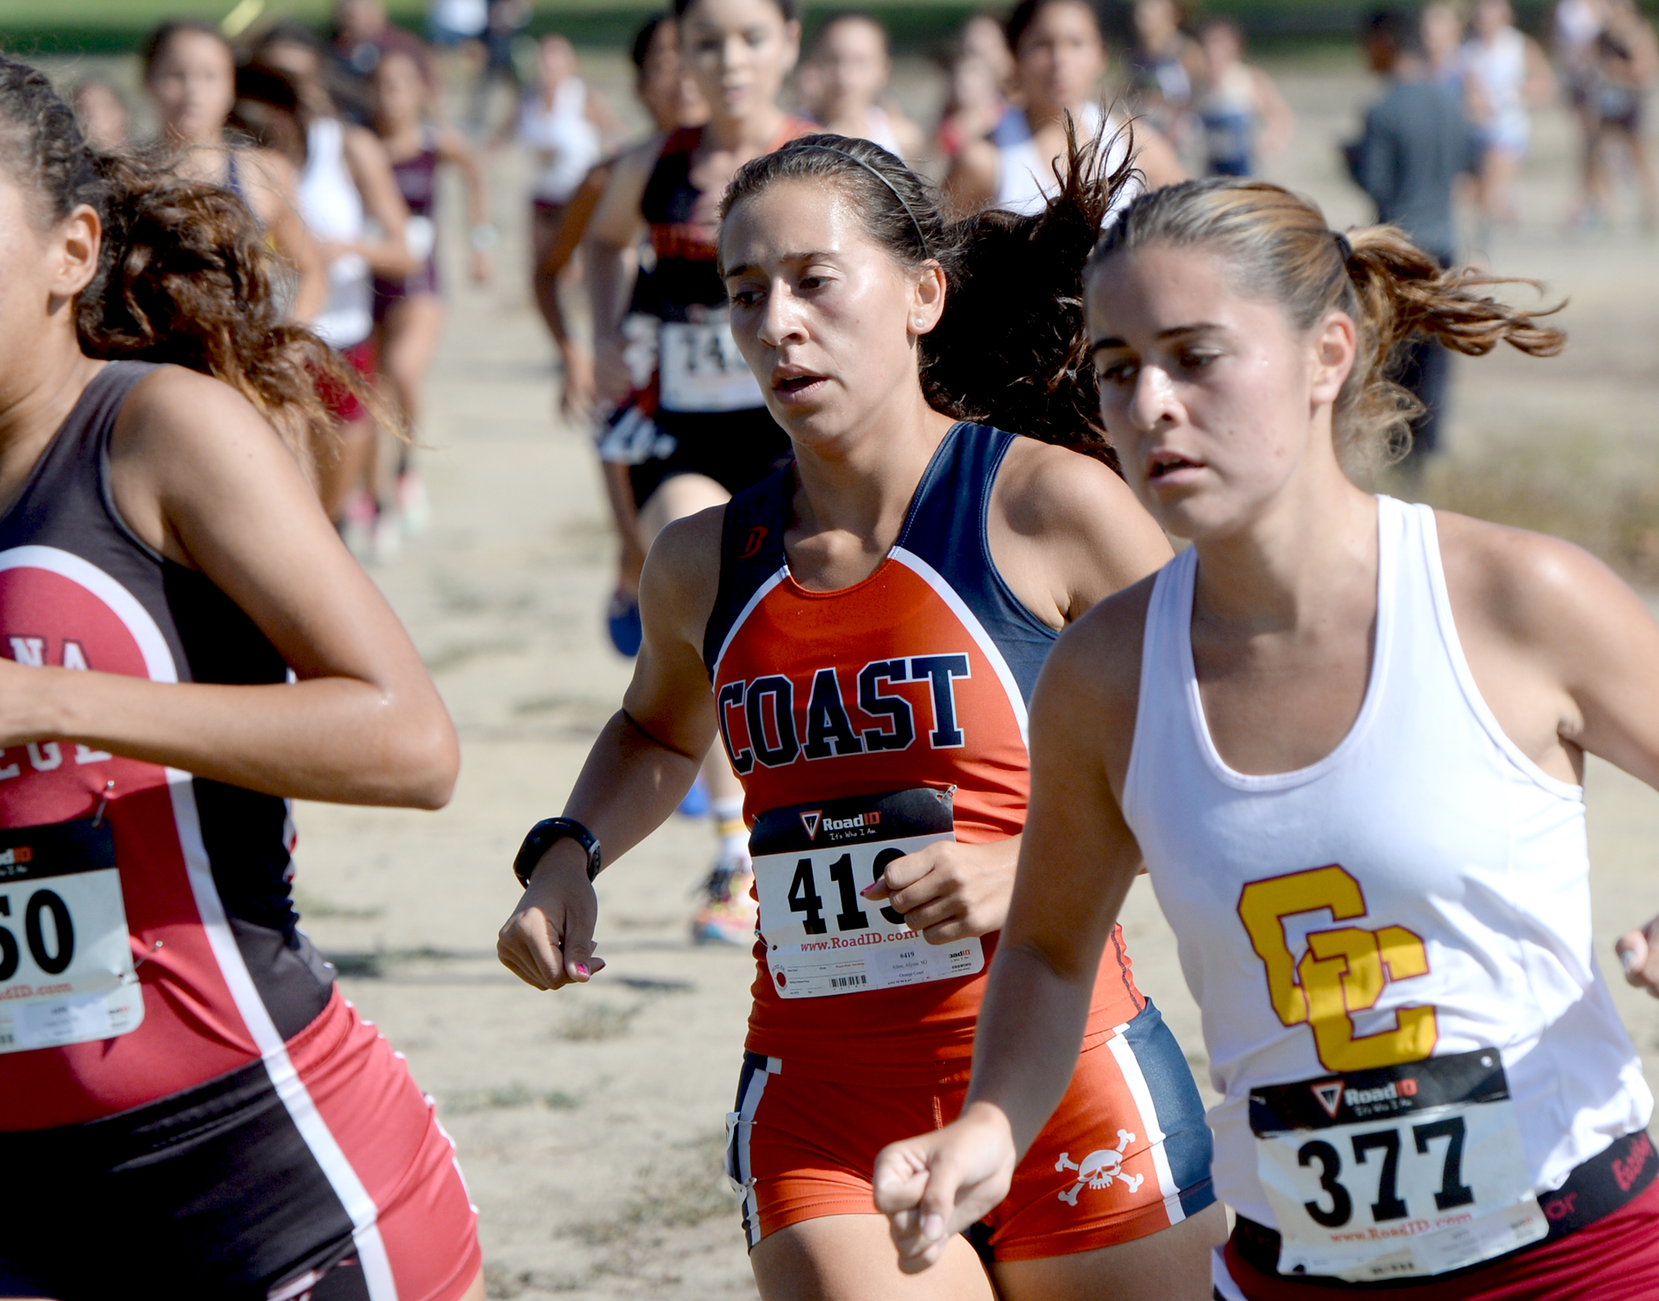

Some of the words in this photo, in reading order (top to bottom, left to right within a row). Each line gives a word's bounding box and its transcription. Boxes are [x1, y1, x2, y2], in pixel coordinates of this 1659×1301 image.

[738, 526, 769, 559] B
[717, 652, 972, 776] COAST
[822, 811, 881, 831] RoadID
[800, 930, 920, 952] www.RoadID.com
[1344, 1078, 1418, 1107] RoadID
[1297, 1115, 1476, 1228] 377
[1329, 1212, 1473, 1244] www.RoadID.com
